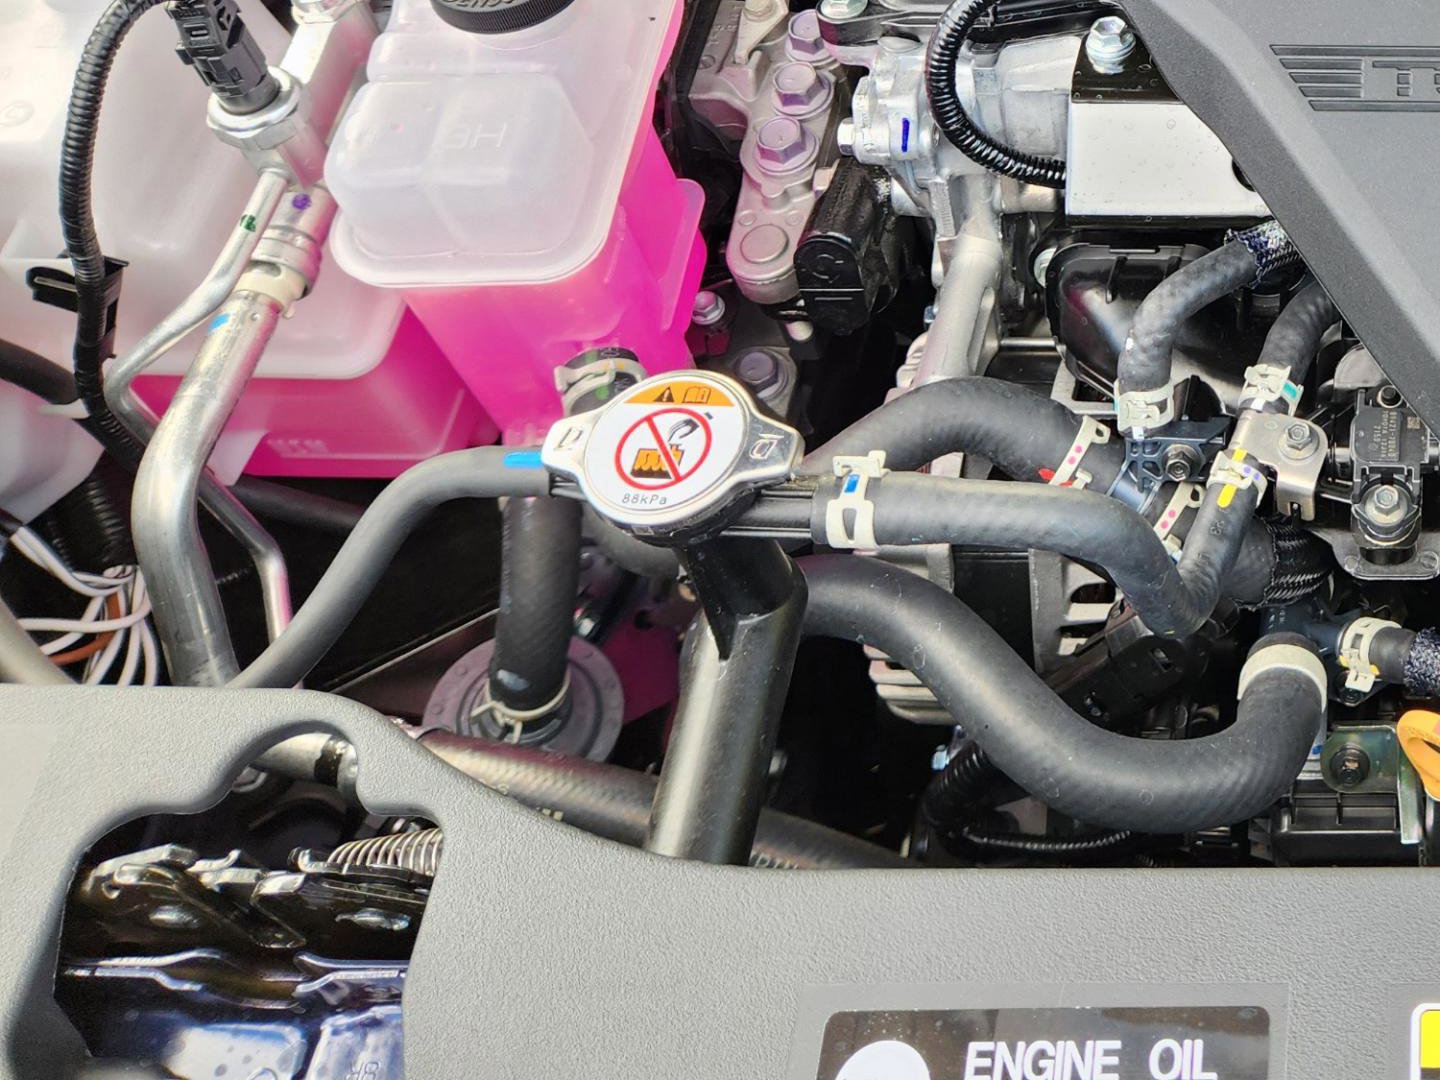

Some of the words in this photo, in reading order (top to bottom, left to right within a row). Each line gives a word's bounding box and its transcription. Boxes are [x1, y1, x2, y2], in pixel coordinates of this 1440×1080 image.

[621, 493, 668, 506] 88kPa
[964, 1040, 1122, 1080] ENGINE
[1148, 1038, 1219, 1080] OIL
